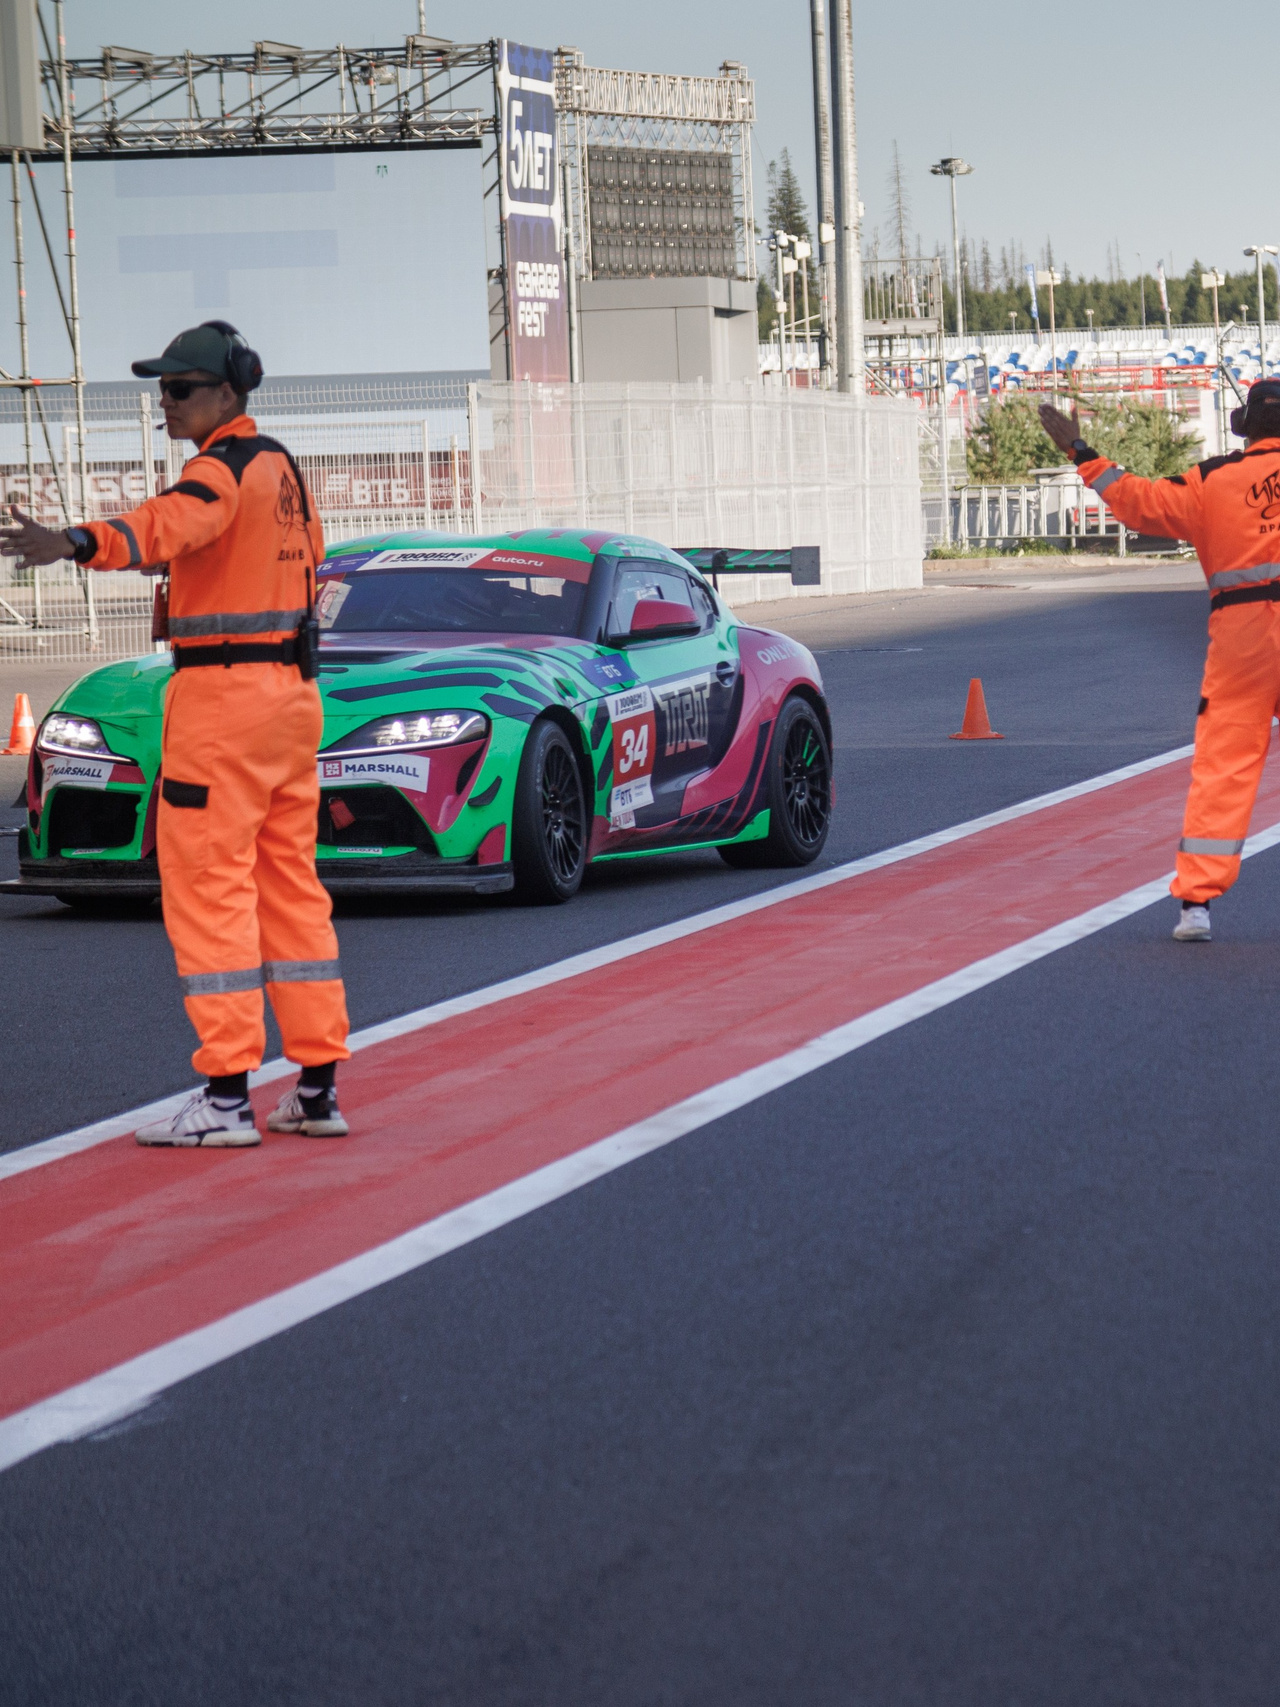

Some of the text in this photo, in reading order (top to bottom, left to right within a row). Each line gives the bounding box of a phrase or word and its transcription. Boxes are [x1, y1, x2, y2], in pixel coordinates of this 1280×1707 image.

[352, 477, 411, 504] ВТБ
[316, 562, 334, 572] ТБ
[492, 555, 545, 567] auto.ru
[602, 664, 622, 679] ВТБ
[619, 724, 649, 774] 34
[52, 766, 103, 779] MARSHALL
[344, 763, 420, 779] MARSHALL
